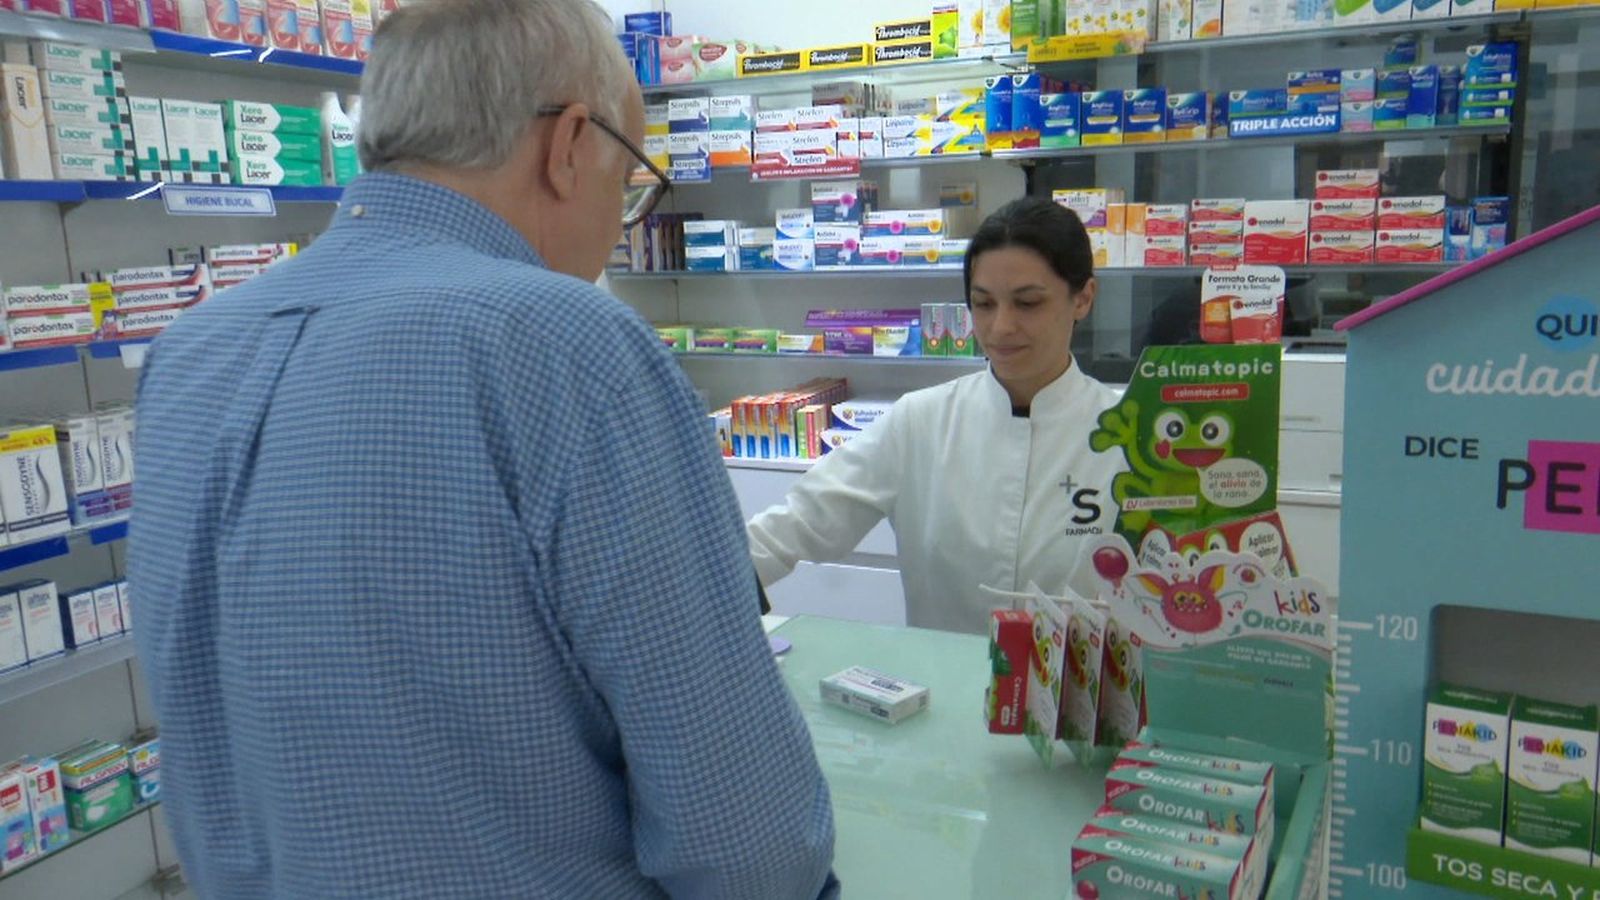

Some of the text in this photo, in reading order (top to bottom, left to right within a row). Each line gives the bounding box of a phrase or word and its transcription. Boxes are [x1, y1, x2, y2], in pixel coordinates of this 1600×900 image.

[47, 42, 81, 57] Lacer
[49, 72, 84, 85] Lacer
[15, 76, 27, 109] Lacer
[52, 100, 88, 112] Lacer
[132, 101, 158, 112] Lacer
[165, 102, 190, 113] Lacer
[194, 105, 219, 116] Lacer
[240, 104, 262, 114] Xero
[240, 114, 267, 124] Lacer
[1231, 113, 1336, 132] TRIPLE ACCIÓN
[58, 127, 94, 139] Lacer
[241, 133, 263, 142] Xero
[241, 141, 268, 152] Lacer
[61, 155, 96, 167] Lacer
[246, 160, 267, 169] Xero
[246, 169, 272, 180] Lacer
[112, 270, 164, 283] parodontax
[1208, 274, 1281, 283] Formato Grande
[8, 291, 70, 305] parodontax
[117, 291, 169, 305] parodontax
[121, 313, 175, 327] parodontax
[13, 321, 75, 335] parodontax
[1140, 358, 1273, 378] Calmatopic
[1174, 387, 1239, 398] calmatopic.com
[1404, 435, 1479, 459] DICE
[17, 456, 34, 516] SENSODYNE
[1220, 480, 1246, 488] alivio
[1496, 458, 1600, 516] PE
[1072, 488, 1101, 525] S
[1274, 590, 1321, 616] kids
[1243, 609, 1326, 636] OROFAR
[1375, 613, 1418, 641] 120
[1432, 719, 1497, 740] PEDIAKID
[1371, 738, 1413, 766] 110
[1518, 738, 1587, 758] PEDIAKID
[1139, 793, 1204, 822] OROFAR
[1106, 865, 1176, 897] OROFAR
[1365, 862, 1407, 890] 100
[1432, 853, 1585, 900] TOS SECA Y
